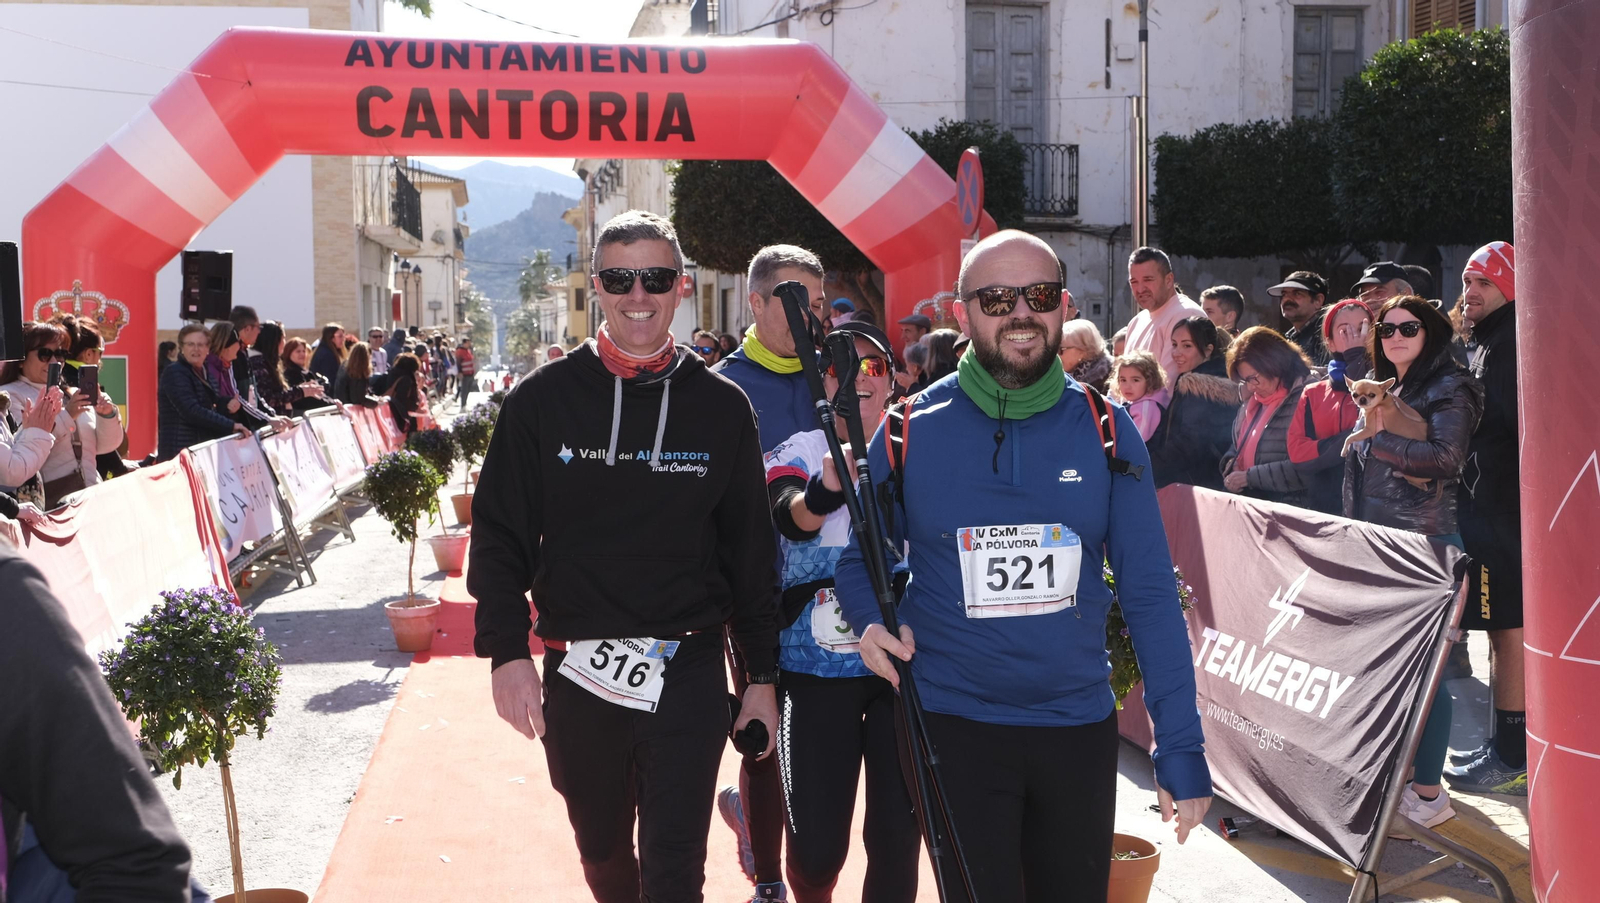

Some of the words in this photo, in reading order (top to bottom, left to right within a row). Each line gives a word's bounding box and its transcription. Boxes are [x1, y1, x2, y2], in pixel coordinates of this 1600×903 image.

[344, 39, 707, 74] AYUNTAMIENTO
[356, 85, 696, 142] CANTORIA
[618, 452, 633, 460] del
[976, 528, 985, 538] IV
[990, 527, 1018, 538] CxM
[986, 539, 1038, 550] PÓLVORA
[986, 554, 1055, 592] 521
[589, 640, 650, 688] 516
[1194, 626, 1355, 719] TEAMERGY
[1206, 702, 1286, 752] www.teamergy.es
